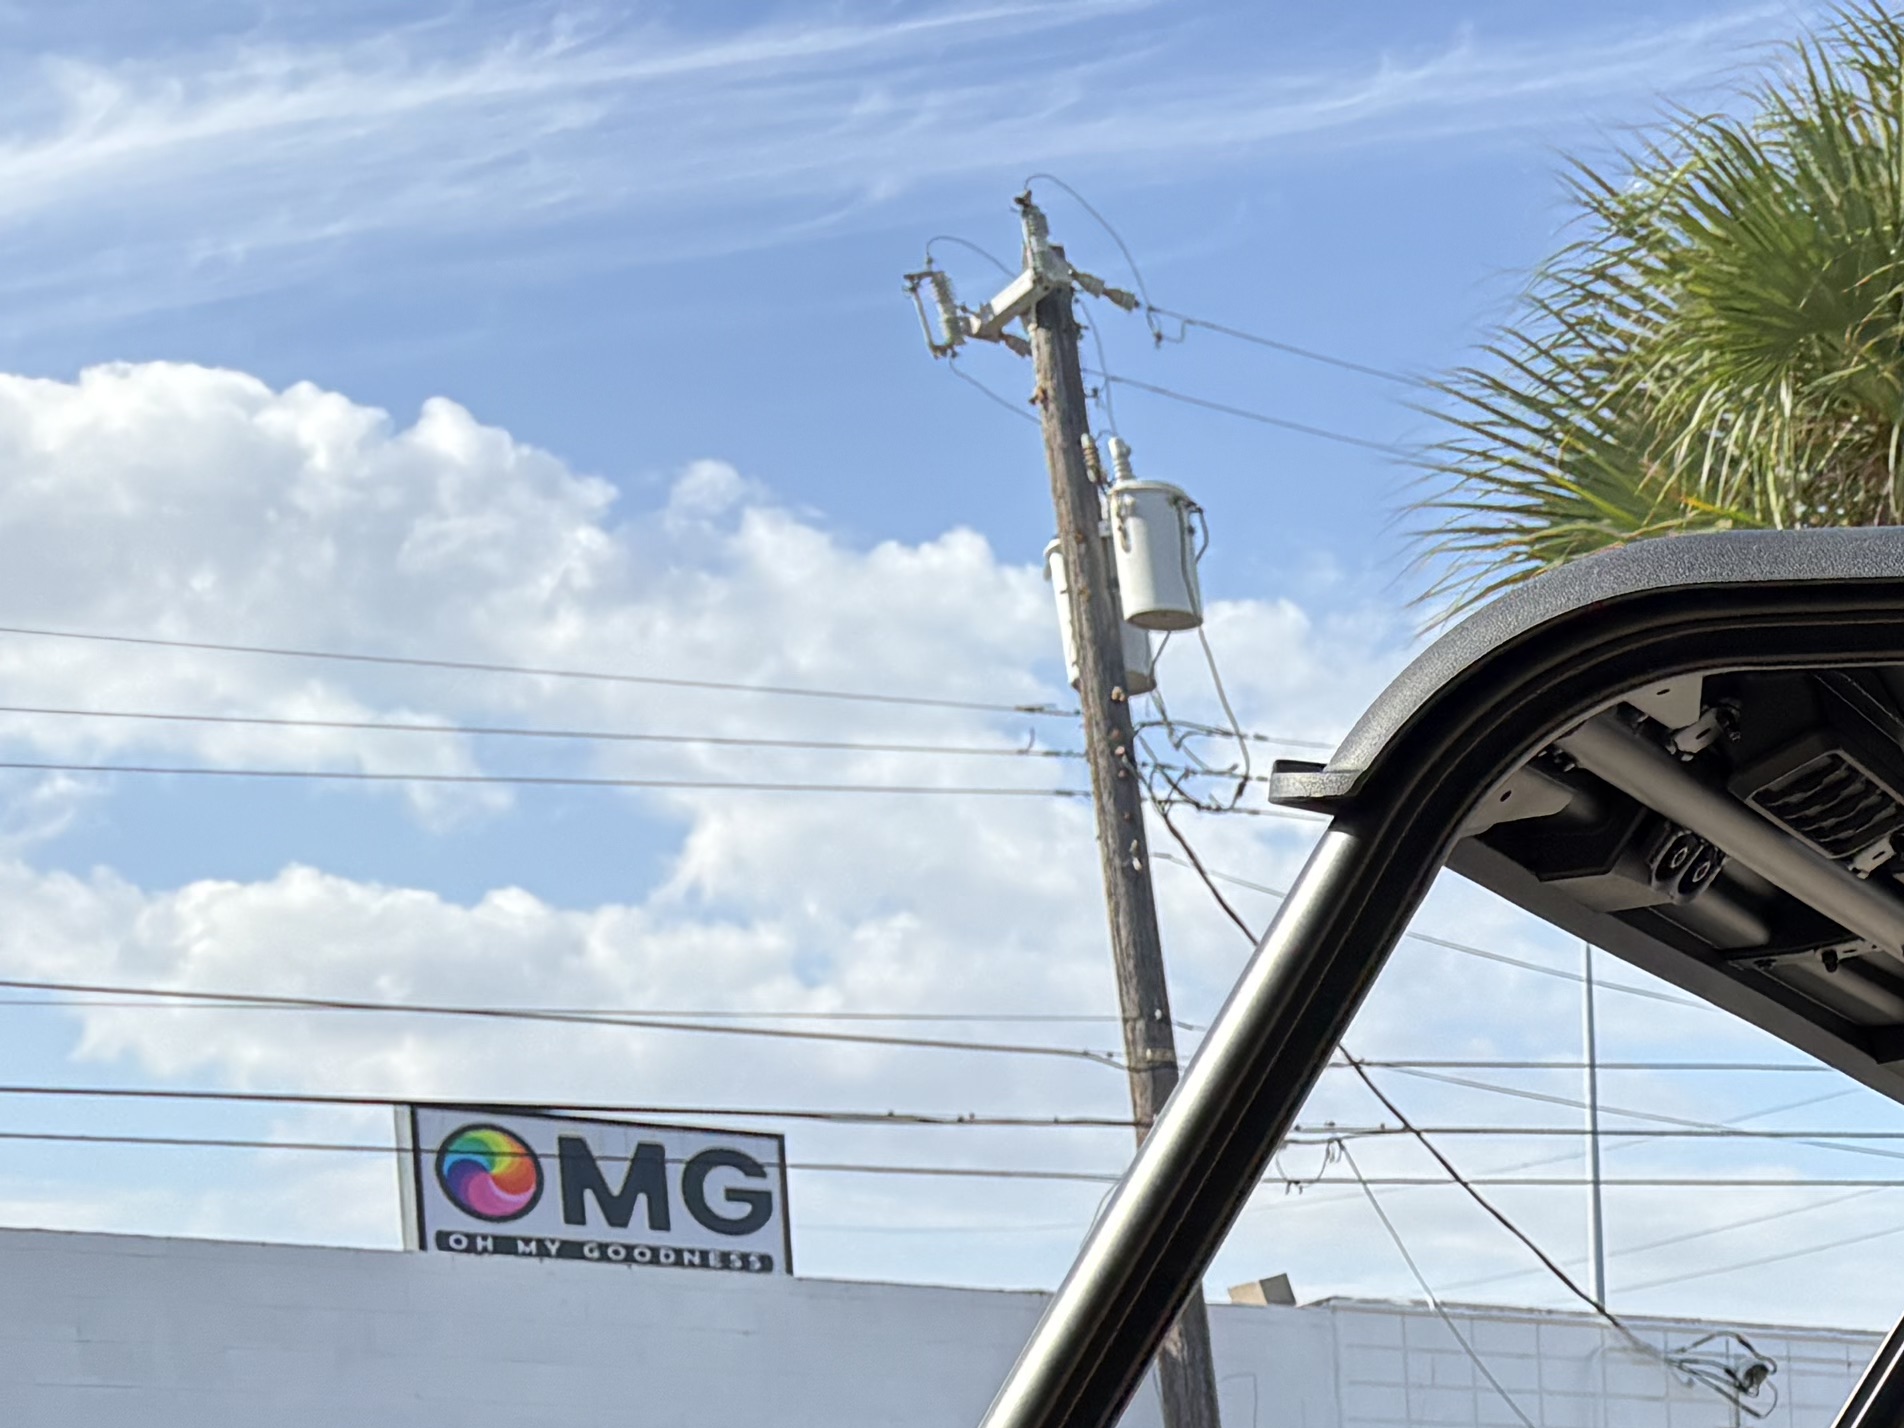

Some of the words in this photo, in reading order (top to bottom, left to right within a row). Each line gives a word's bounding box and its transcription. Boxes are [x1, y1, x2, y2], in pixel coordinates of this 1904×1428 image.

[435, 1123, 774, 1236] OMG
[449, 1233, 494, 1253] OH
[516, 1239, 563, 1257] MY
[583, 1244, 763, 1272] GOODNESS
